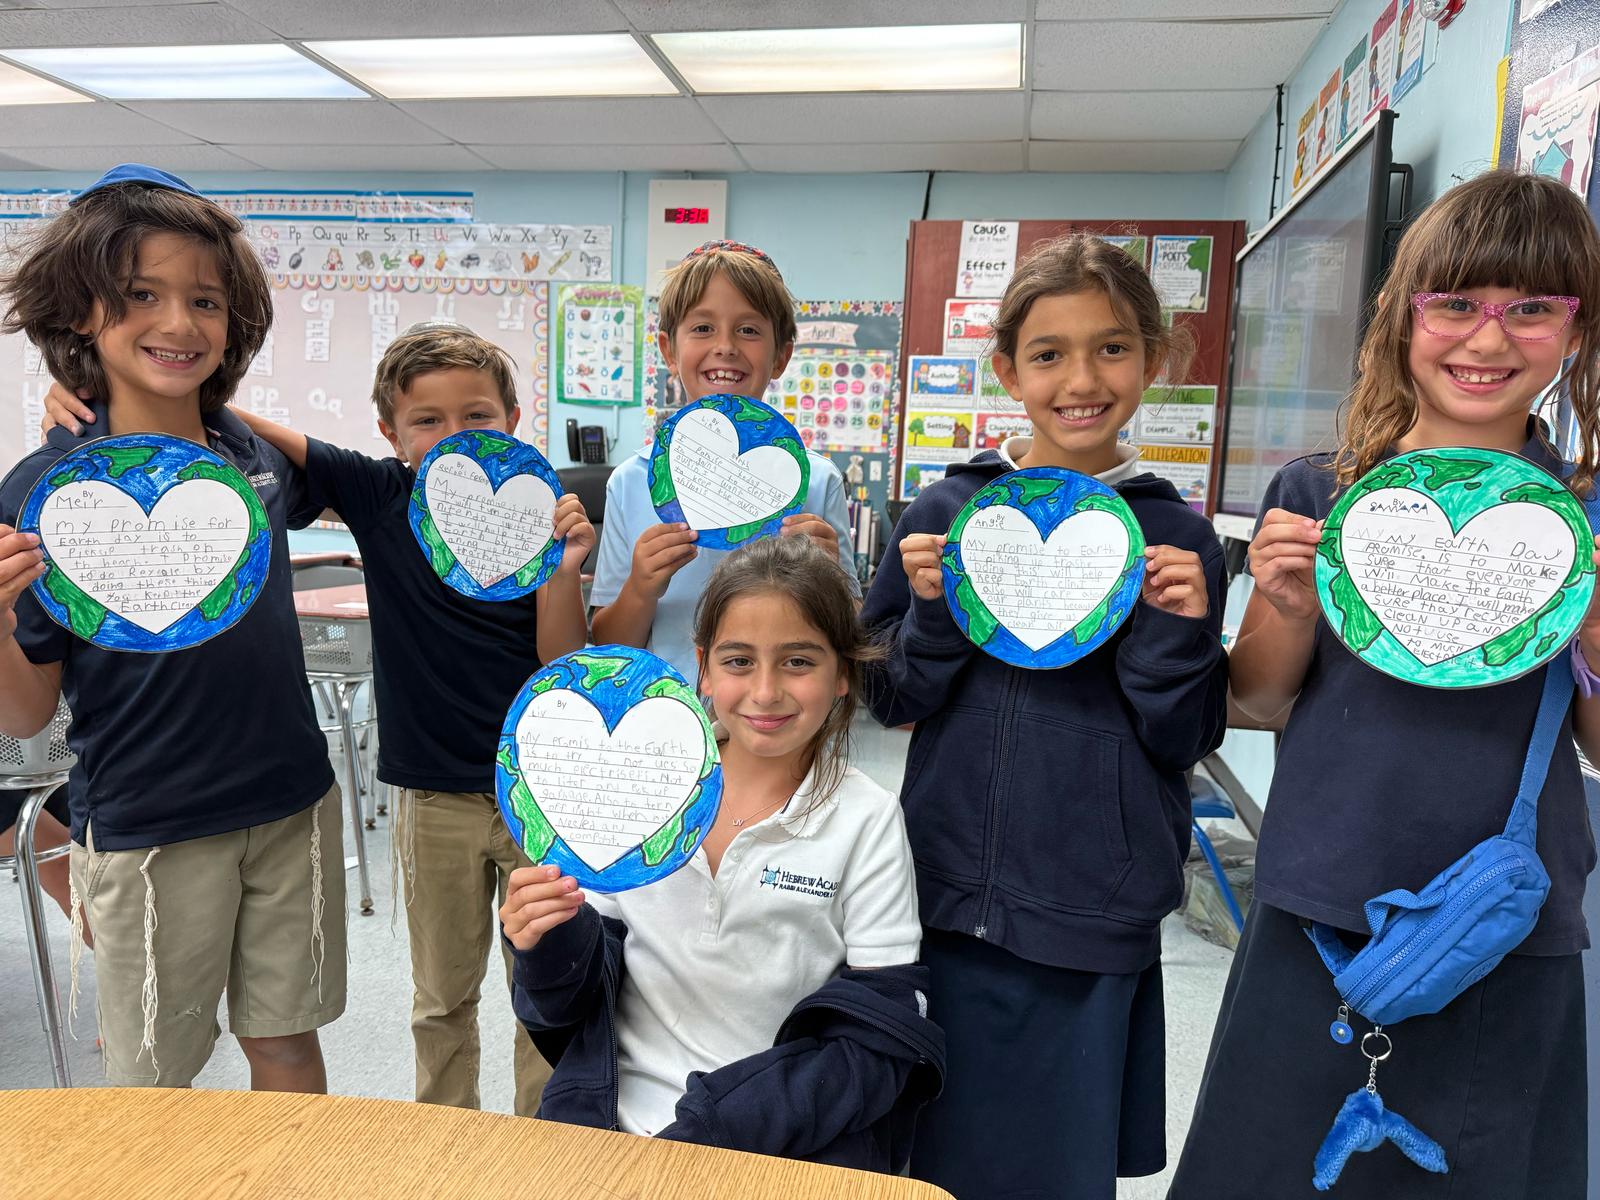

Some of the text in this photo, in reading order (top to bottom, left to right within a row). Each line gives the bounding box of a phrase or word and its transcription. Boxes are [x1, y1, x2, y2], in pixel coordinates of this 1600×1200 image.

[973, 224, 1006, 236] Cause
[289, 224, 301, 244] Pp
[551, 229, 568, 249] Yy
[583, 229, 597, 244] Zz
[966, 261, 1007, 270] Effect
[811, 327, 836, 338] April
[817, 416, 879, 425] 23 24 25 26
[927, 423, 952, 431] Setting
[816, 431, 827, 440] 30
[433, 477, 456, 500] My
[82, 491, 94, 499] By
[56, 495, 104, 510] Meir
[1393, 499, 1404, 508] By
[207, 516, 232, 529] for
[996, 514, 1005, 522] By
[60, 537, 101, 546] Earth
[114, 532, 141, 543] day
[182, 531, 196, 541] to
[1057, 545, 1069, 555] to
[1434, 536, 1490, 553] Earth
[1511, 541, 1563, 562] Day
[1470, 555, 1487, 567] to
[194, 564, 215, 574] by
[1374, 580, 1410, 597] better
[1457, 593, 1468, 607] I
[1477, 599, 1499, 610] will
[1466, 581, 1490, 595] the
[1497, 587, 1533, 604] Earth
[121, 601, 168, 612] Earth
[557, 700, 567, 709] By
[618, 740, 641, 753] the
[644, 739, 689, 756] Earth
[528, 762, 562, 772] much
[781, 871, 816, 887] HEBREW
[796, 886, 830, 897] ALEXANDER
